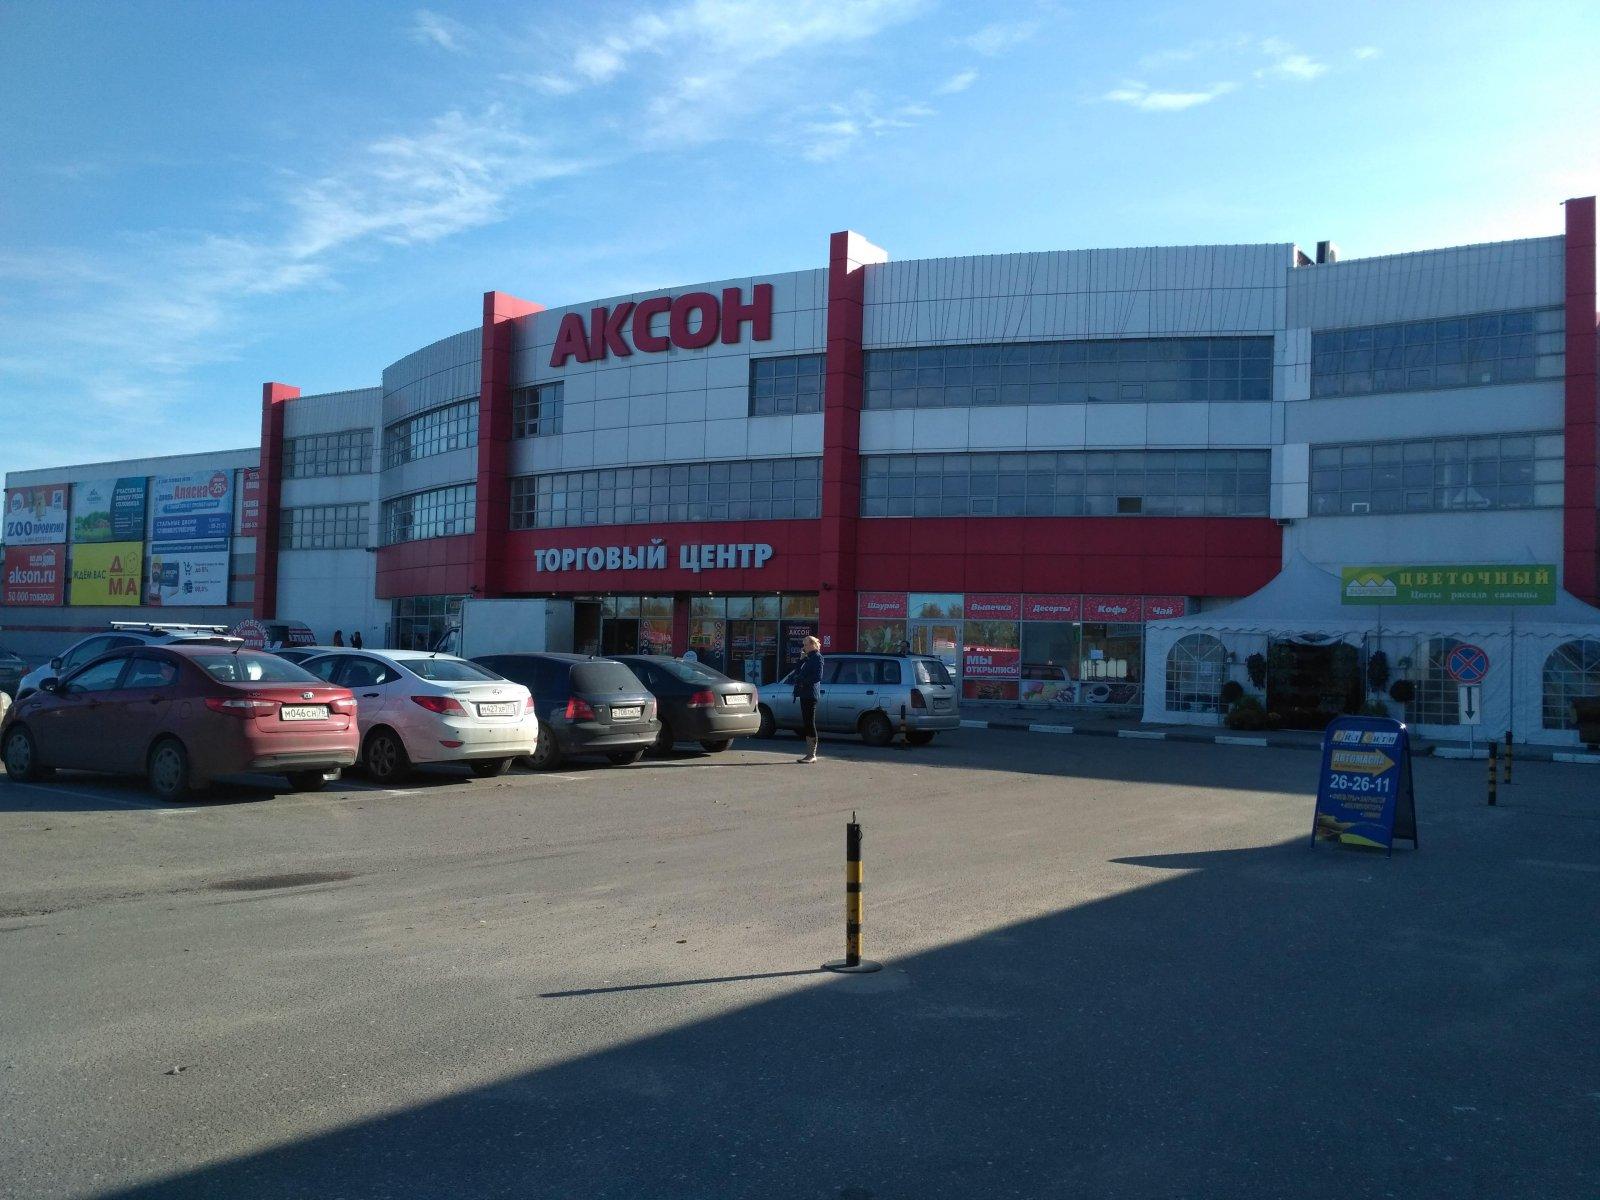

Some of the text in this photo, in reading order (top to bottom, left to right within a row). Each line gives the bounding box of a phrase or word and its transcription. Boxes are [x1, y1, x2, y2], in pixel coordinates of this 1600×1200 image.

[549, 283, 773, 368] АКСОН
[534, 536, 774, 574] ТОРГОВЫЙ ЦЕНТР
[9, 565, 56, 584] akson.ru
[1399, 569, 1549, 587] ЦВЕТОЧНЫЙ
[29, 592, 55, 604] товаров
[1410, 590, 1538, 600] Цветы рассада саженцы
[867, 602, 900, 611] Шаурма
[971, 603, 1012, 611] Выпечка
[1033, 604, 1071, 614] Десерты
[1098, 604, 1128, 615] Кофе
[1152, 605, 1174, 615] Чай
[966, 655, 993, 665] МЫ
[966, 665, 1019, 674] ОТКРЫЛИСЬ!
[1329, 774, 1390, 793] 26-26-11
